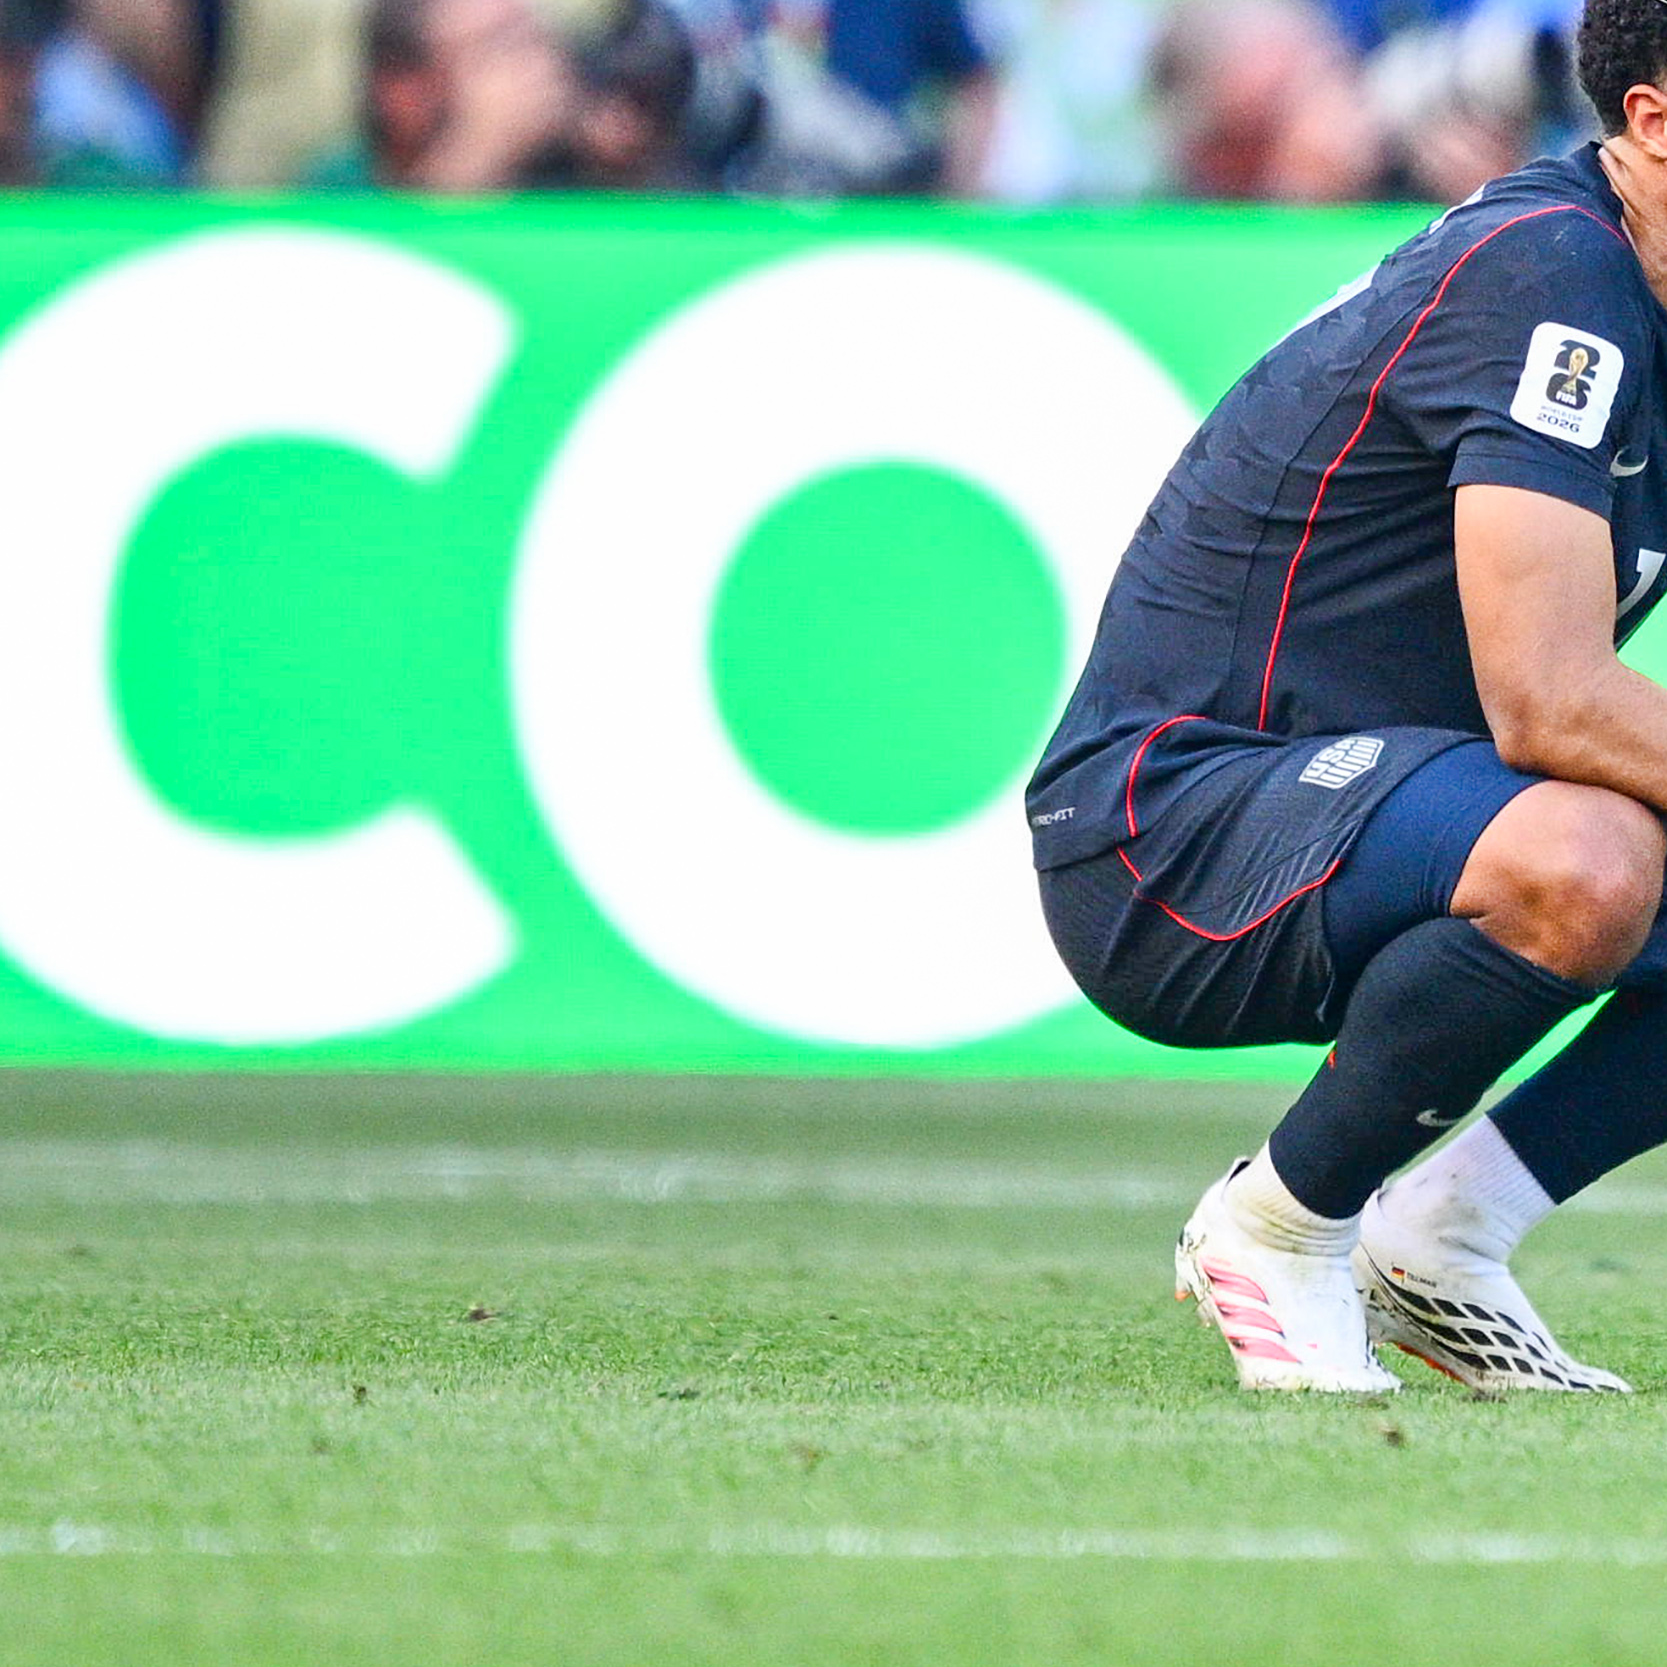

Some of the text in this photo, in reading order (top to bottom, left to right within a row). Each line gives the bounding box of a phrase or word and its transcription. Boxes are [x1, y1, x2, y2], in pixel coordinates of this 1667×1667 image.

[1537, 413, 1580, 433] 2026
[0, 225, 1200, 1048] CO
[1305, 739, 1358, 777] USA
